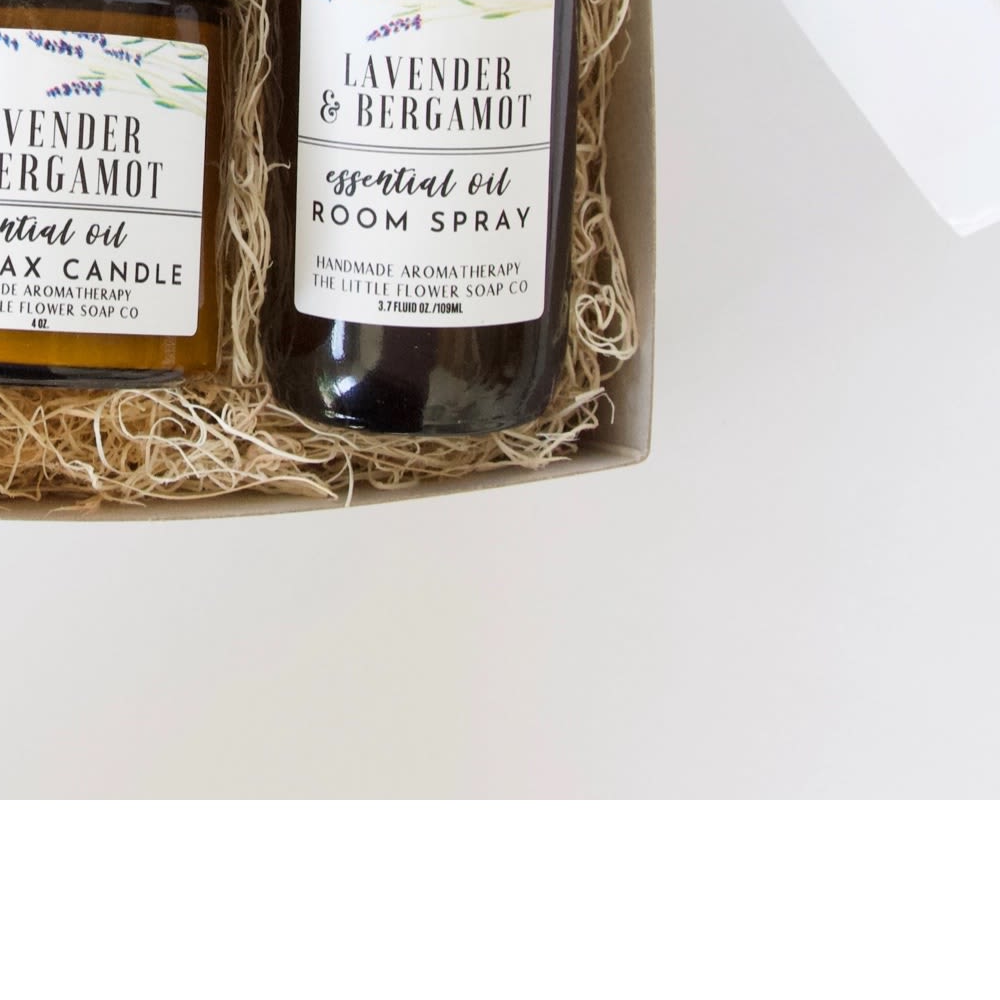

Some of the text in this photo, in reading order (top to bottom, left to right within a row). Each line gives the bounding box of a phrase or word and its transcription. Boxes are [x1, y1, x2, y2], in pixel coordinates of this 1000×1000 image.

[344, 53, 512, 92] LAVENDER
[320, 89, 532, 131] & BERGAMOT
[326, 167, 511, 198] essential oil
[312, 200, 530, 232] ROOM SPRAY
[86, 221, 128, 248] oil
[63, 258, 183, 285] CANDLE
[316, 255, 521, 279] HANDMADE AROMATHERAPY
[23, 285, 132, 301] AROMATHERAPY
[312, 273, 528, 299] THE LITTLE FLOWER SOAP CO
[19, 301, 75, 317] FLOWER
[80, 304, 115, 318] SOAP
[120, 306, 139, 319] CO
[378, 301, 392, 312] 3.7
[394, 301, 417, 313] FLUID
[31, 319, 37, 328] 4
